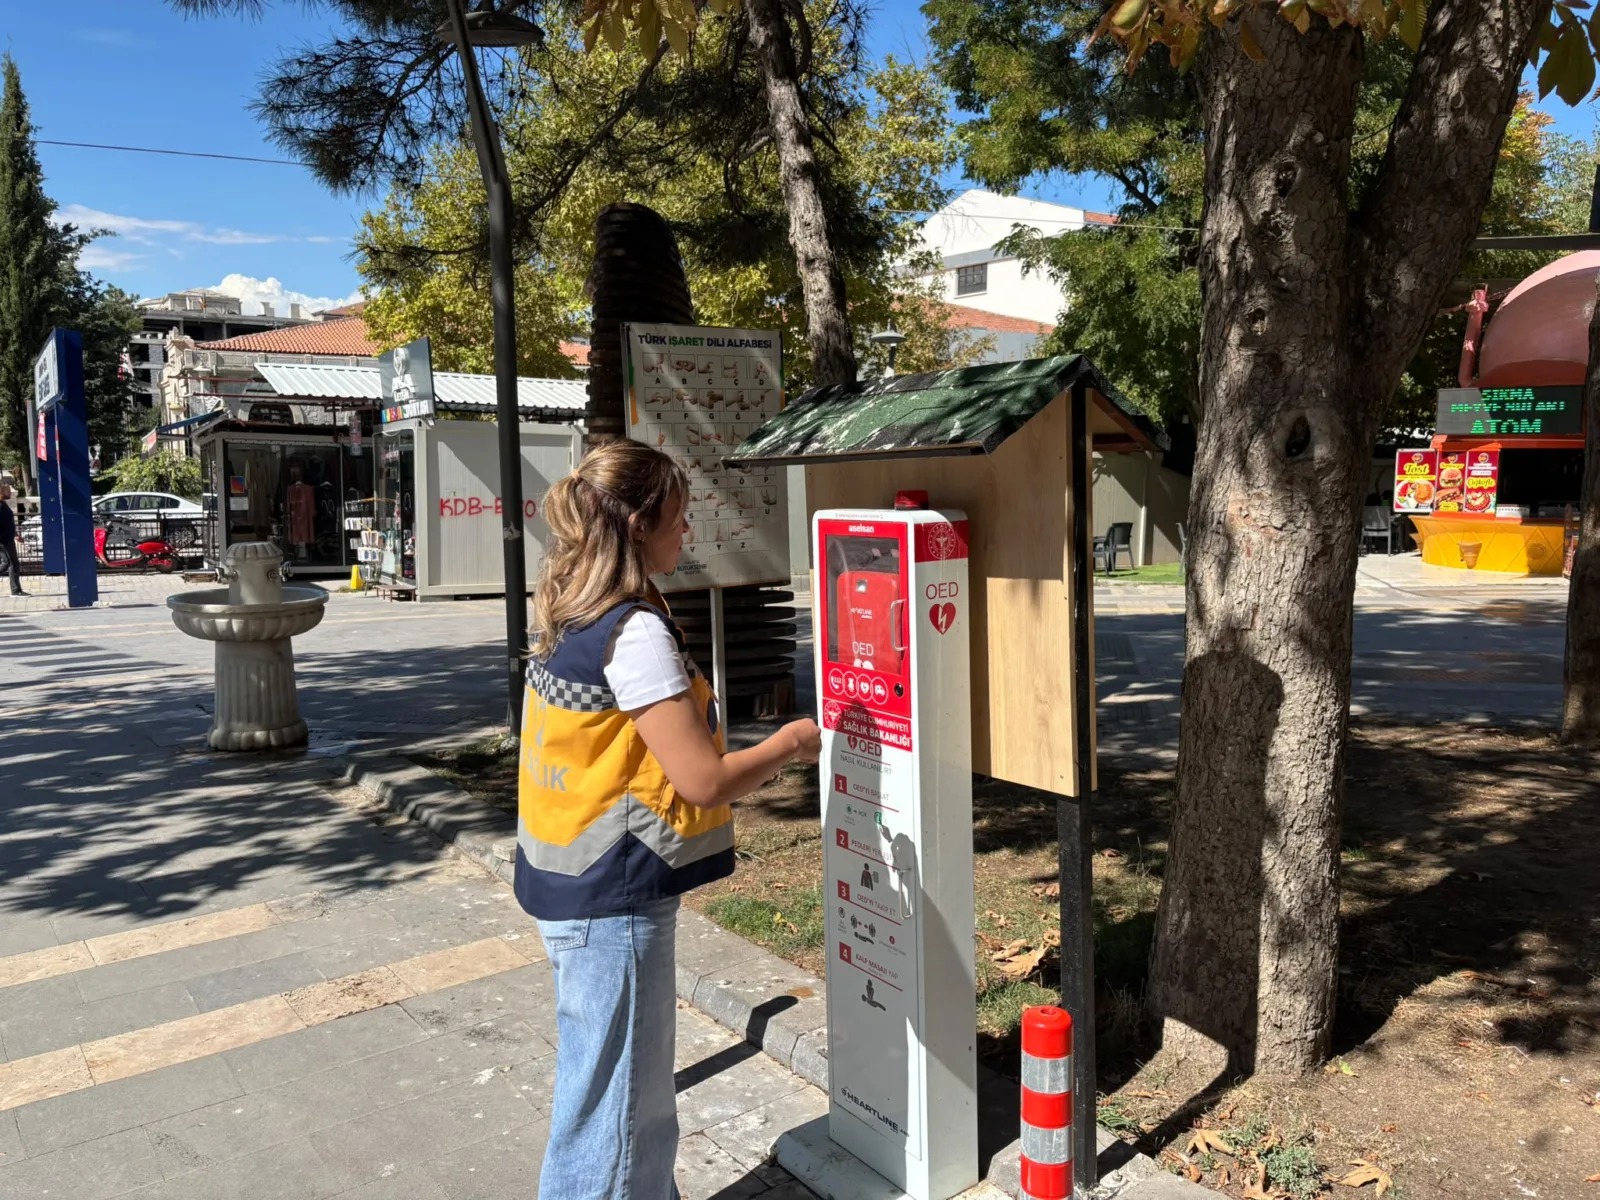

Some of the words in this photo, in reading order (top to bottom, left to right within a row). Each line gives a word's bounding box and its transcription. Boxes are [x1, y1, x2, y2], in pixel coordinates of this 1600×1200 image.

[638, 333, 667, 345] TÜRK
[668, 335, 705, 347] İŞARET
[707, 337, 725, 348] DİLİ
[727, 338, 772, 349] ALFABESİ
[1470, 418, 1542, 434] ATOM
[1404, 463, 1427, 474] Tost
[926, 581, 959, 600] OED
[852, 641, 874, 657] OED
[844, 708, 868, 721] TÜRKİYE
[868, 715, 909, 733] CUMHURİYETİ
[843, 720, 868, 736] SAĞLIK
[869, 728, 911, 748] BAKANLIĞI
[859, 740, 882, 757] OED
[847, 1091, 899, 1132] HEARTLINE
